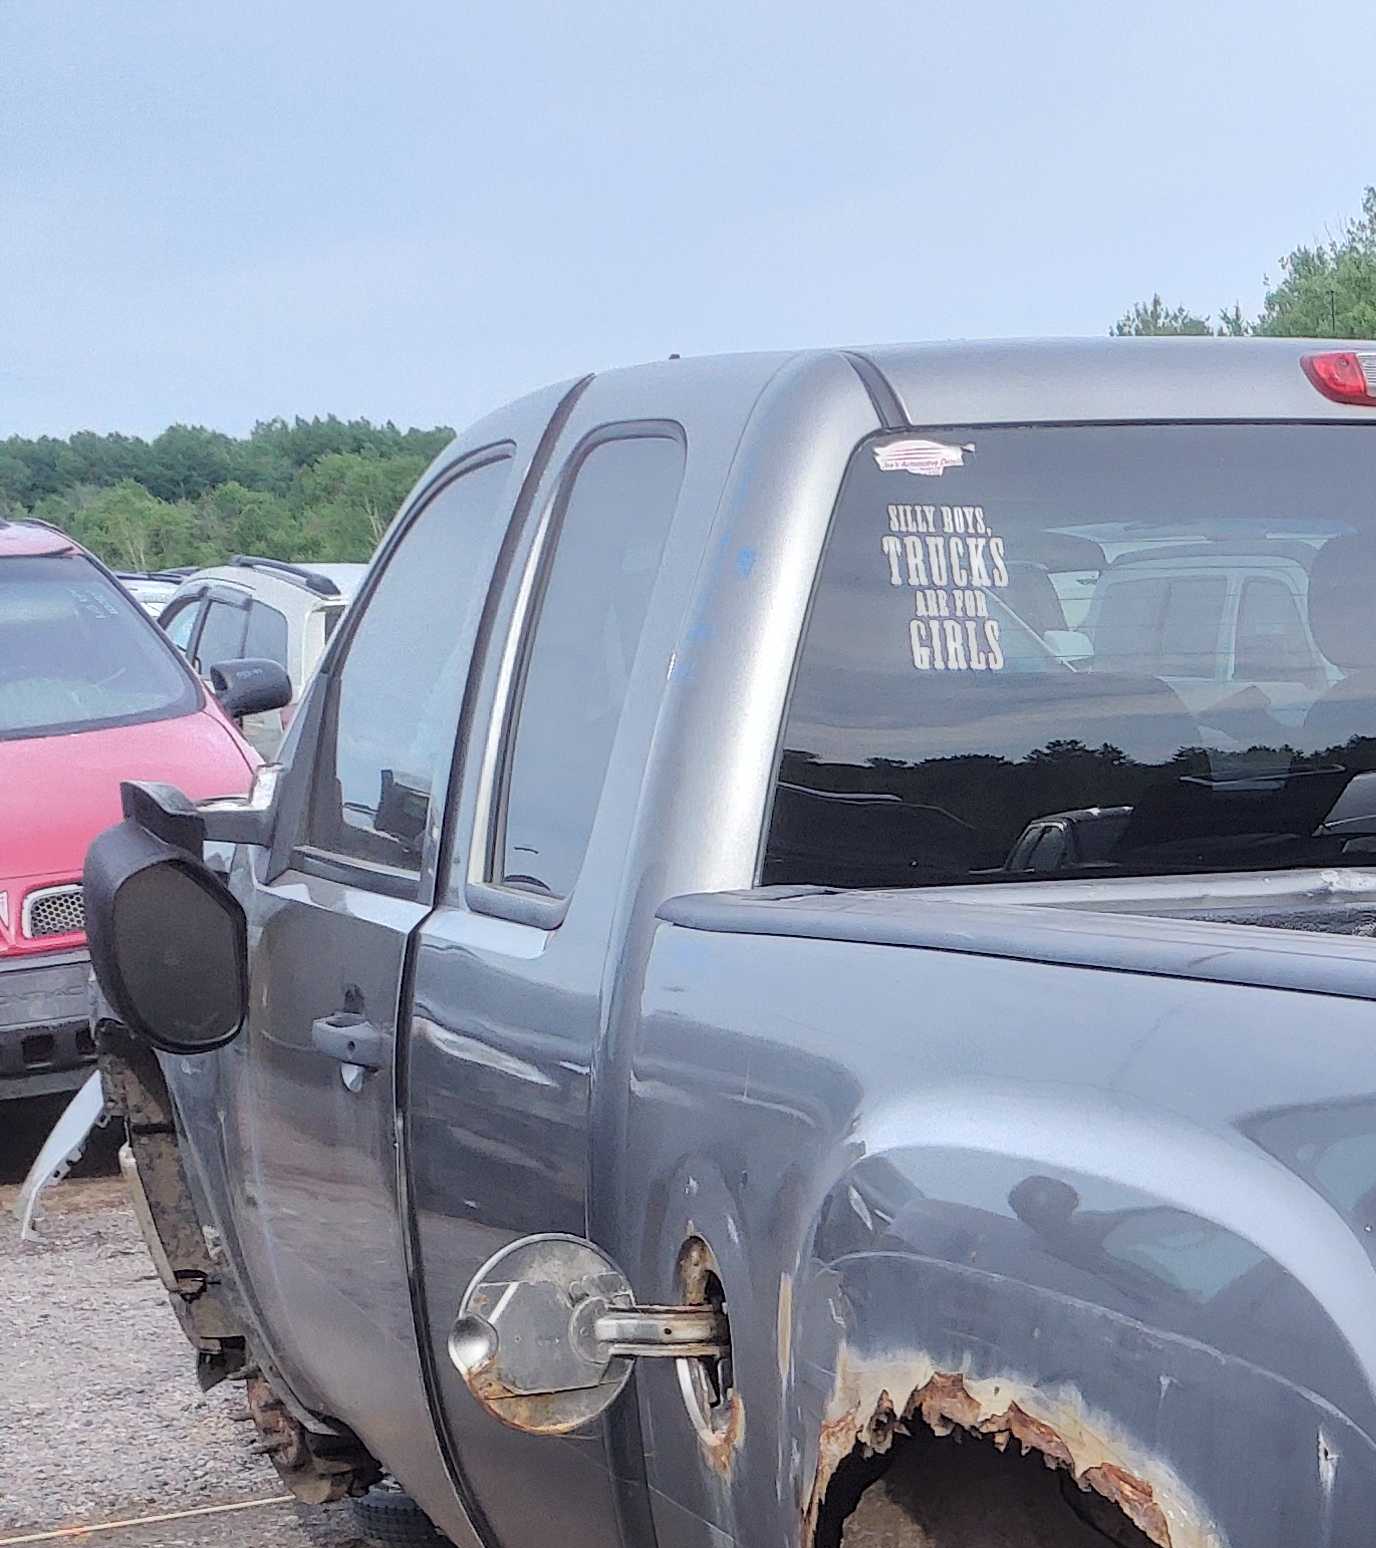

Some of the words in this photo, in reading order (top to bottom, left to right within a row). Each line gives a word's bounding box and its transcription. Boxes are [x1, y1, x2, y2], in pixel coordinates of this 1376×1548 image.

[888, 504, 936, 532] SILLY
[941, 506, 993, 536] BOYS,
[881, 536, 1009, 588] TRUCKS
[915, 590, 950, 617] ARE
[952, 590, 989, 617] FOR
[910, 620, 1004, 670] GIRLS
